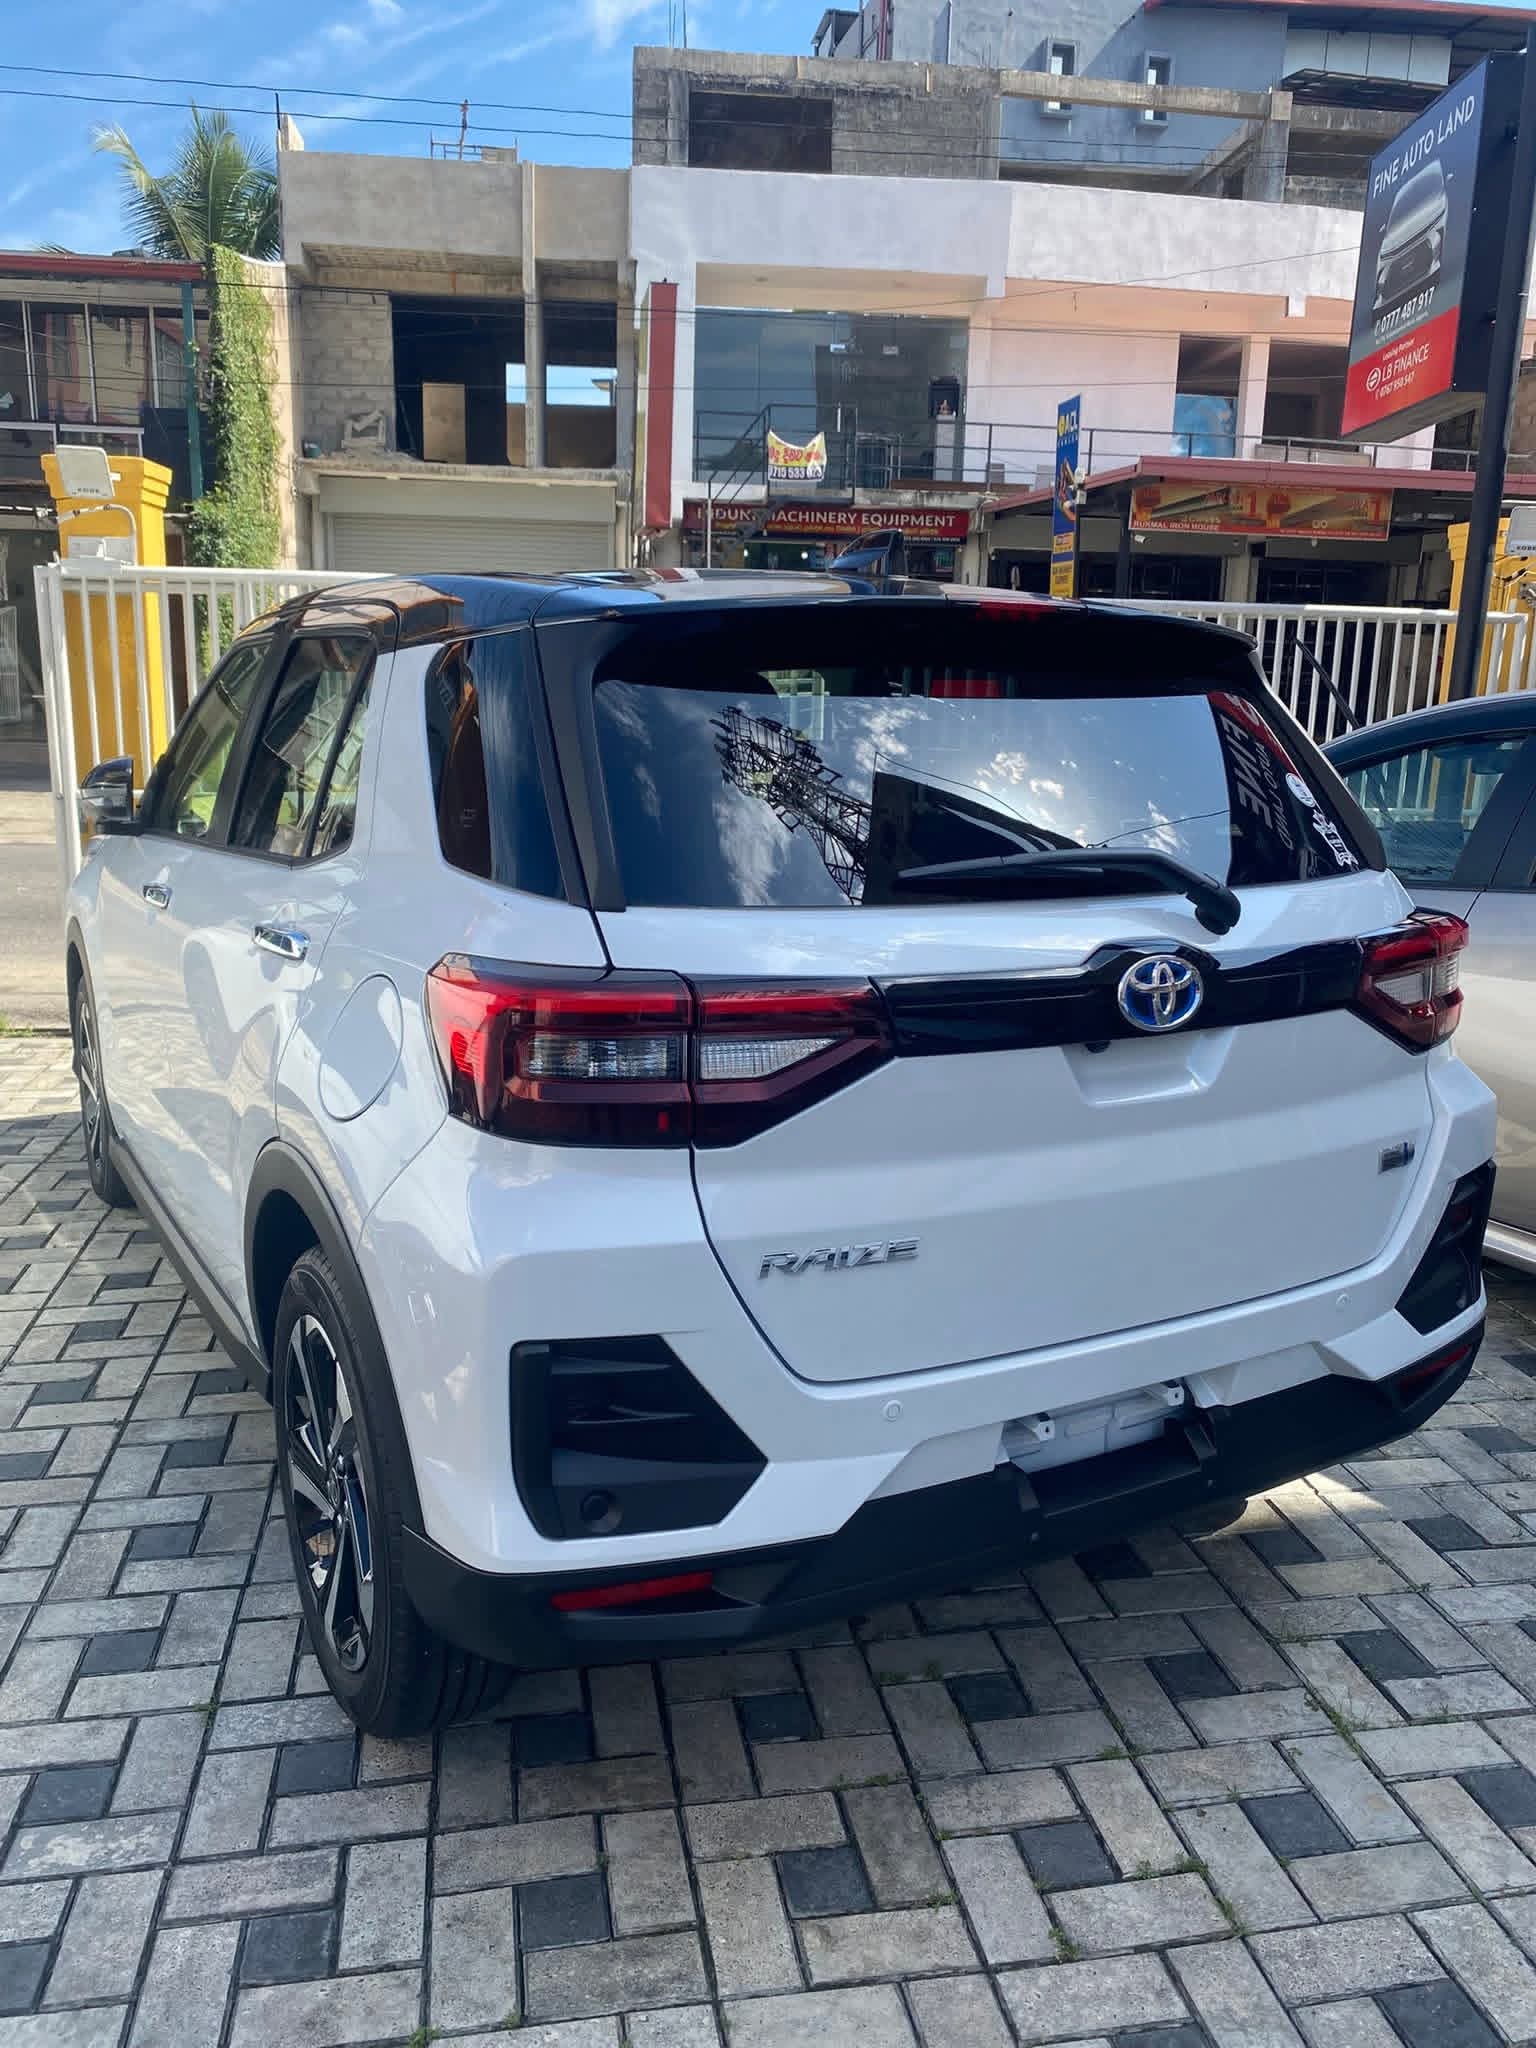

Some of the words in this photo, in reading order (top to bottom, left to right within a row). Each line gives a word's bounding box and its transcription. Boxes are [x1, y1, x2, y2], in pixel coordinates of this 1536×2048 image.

[1373, 158, 1400, 198] FINE
[1401, 129, 1434, 175] AUTO
[1437, 95, 1475, 144] LAND
[1381, 307, 1401, 333] 0777
[1401, 298, 1418, 319] 487
[1418, 286, 1435, 311] 917
[1382, 362, 1393, 381] LB
[1393, 343, 1430, 374] FINANCE
[862, 513, 956, 527] EQUIPMENT
[759, 1236, 921, 1279] RAIZE
